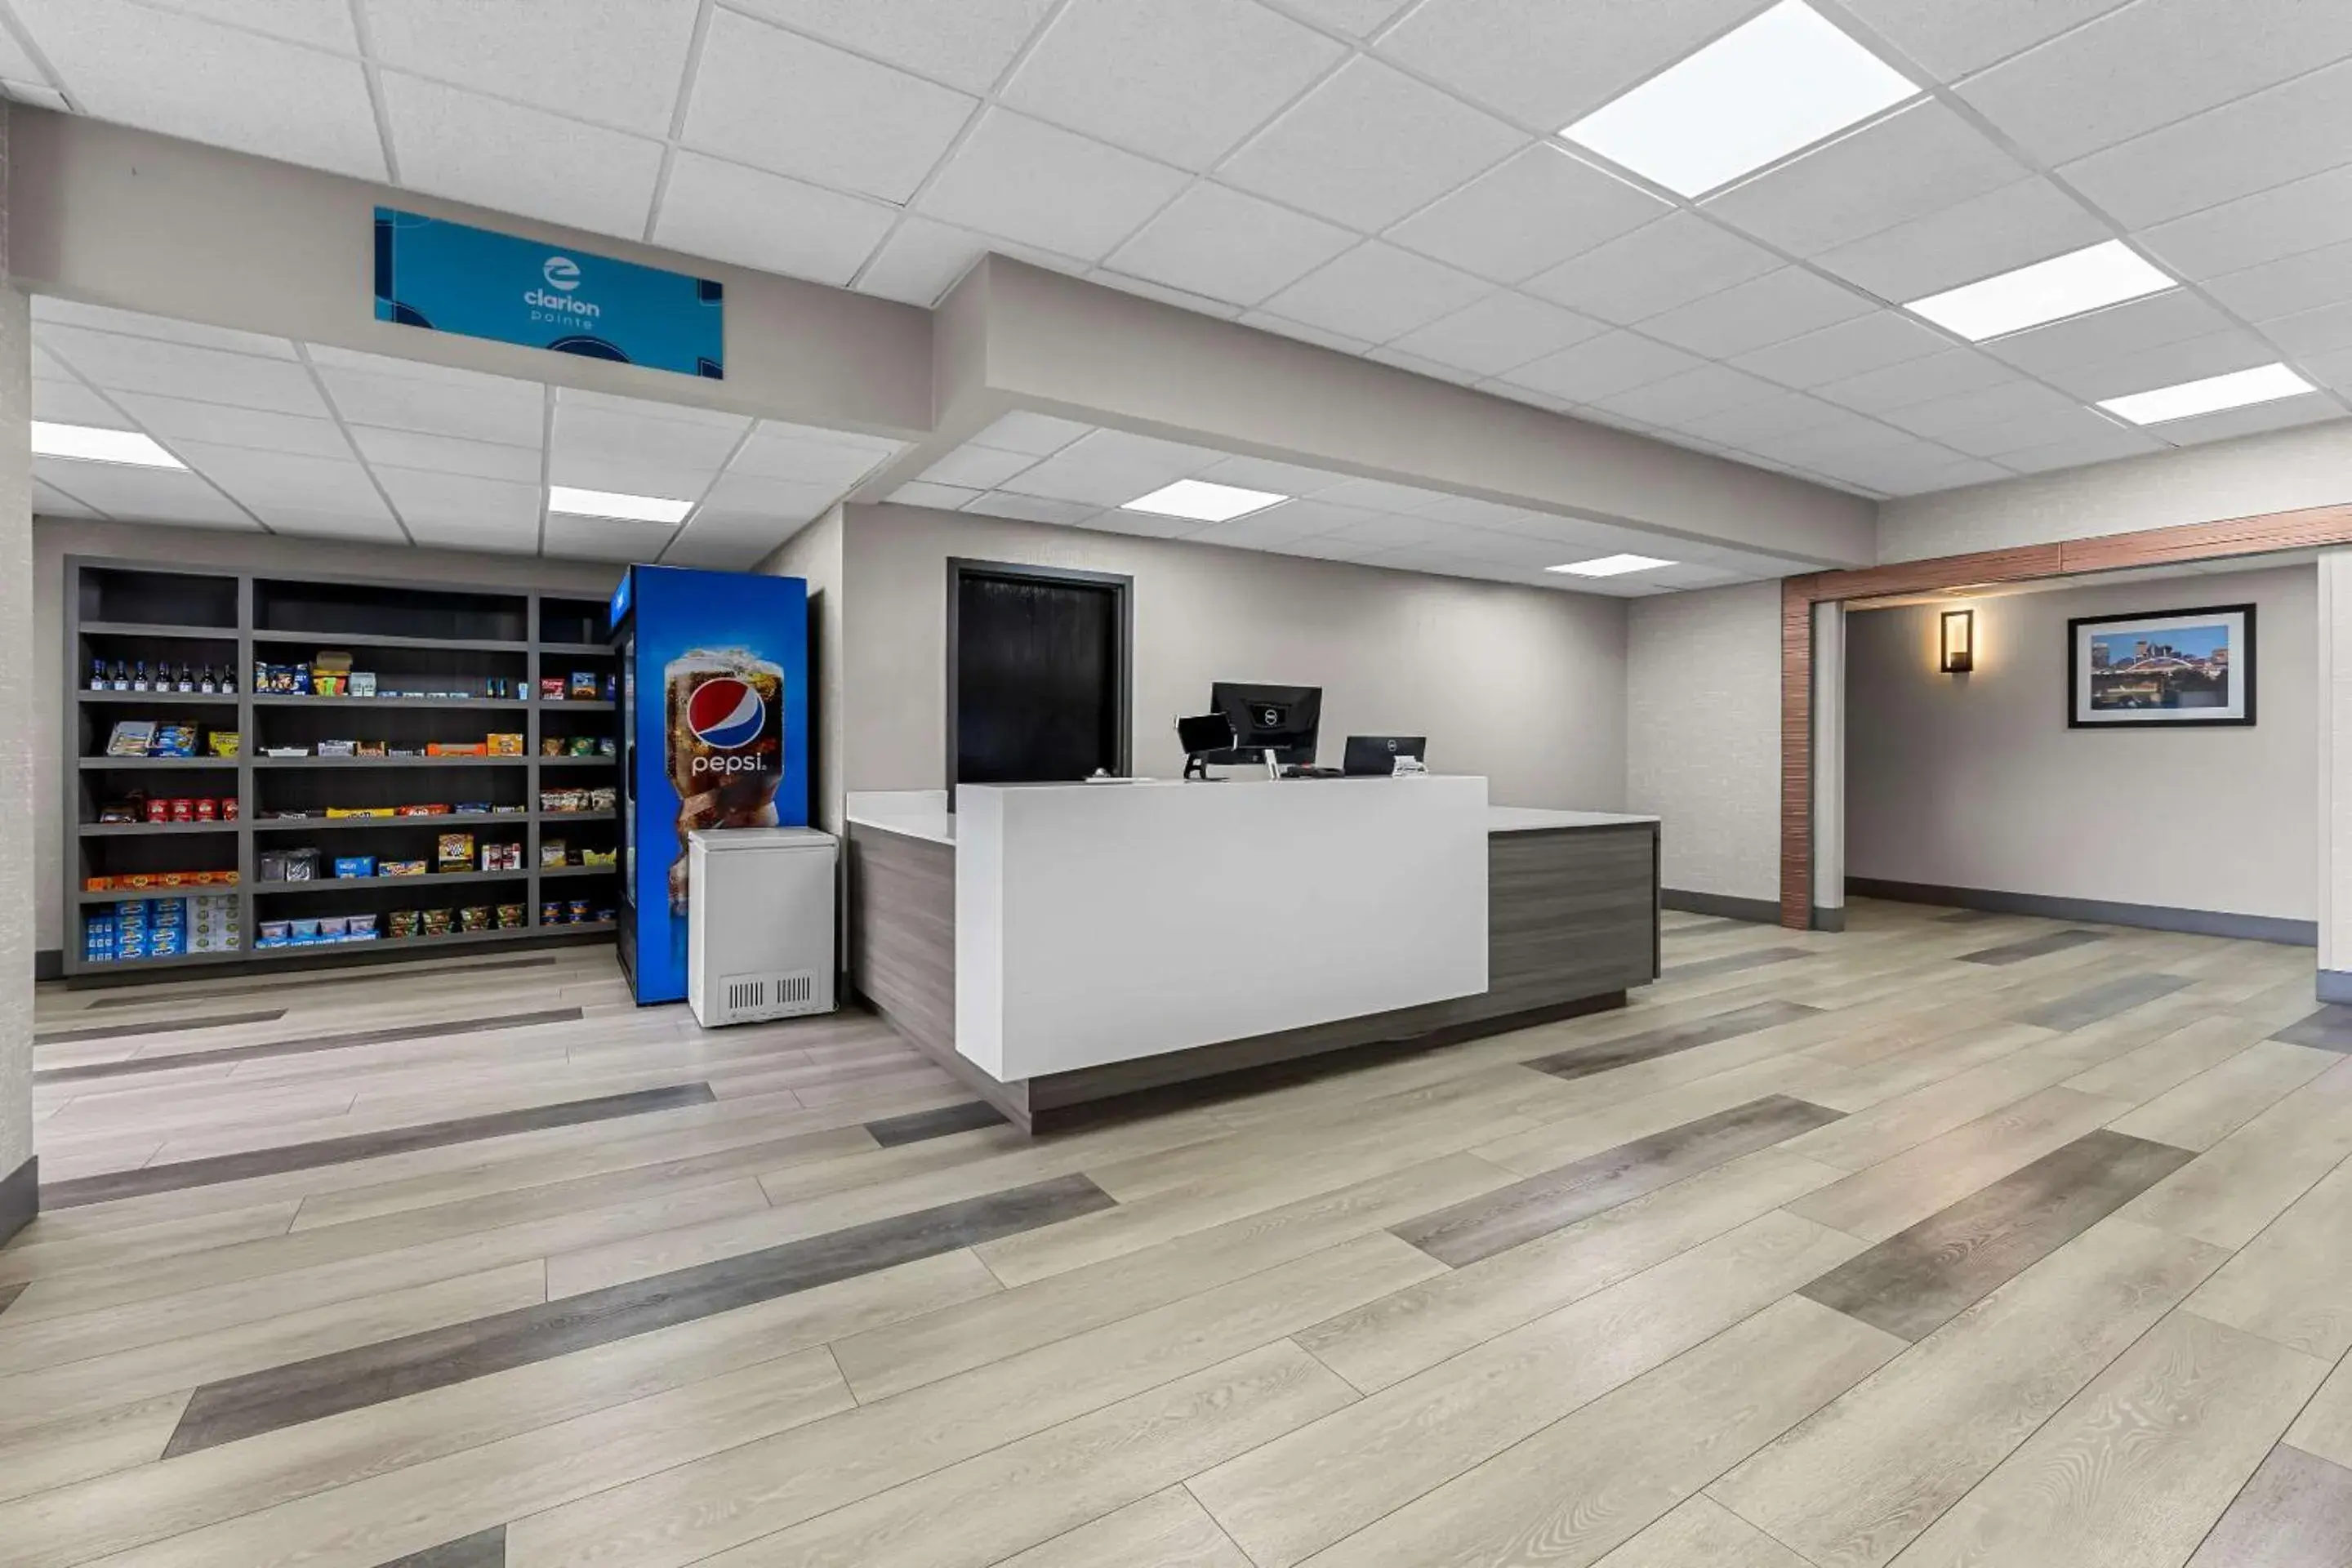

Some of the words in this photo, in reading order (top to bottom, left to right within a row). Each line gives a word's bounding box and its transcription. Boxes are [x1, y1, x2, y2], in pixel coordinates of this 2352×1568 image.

[523, 288, 599, 318] clarion
[531, 310, 592, 330] pointe
[693, 752, 761, 777] pepsi
